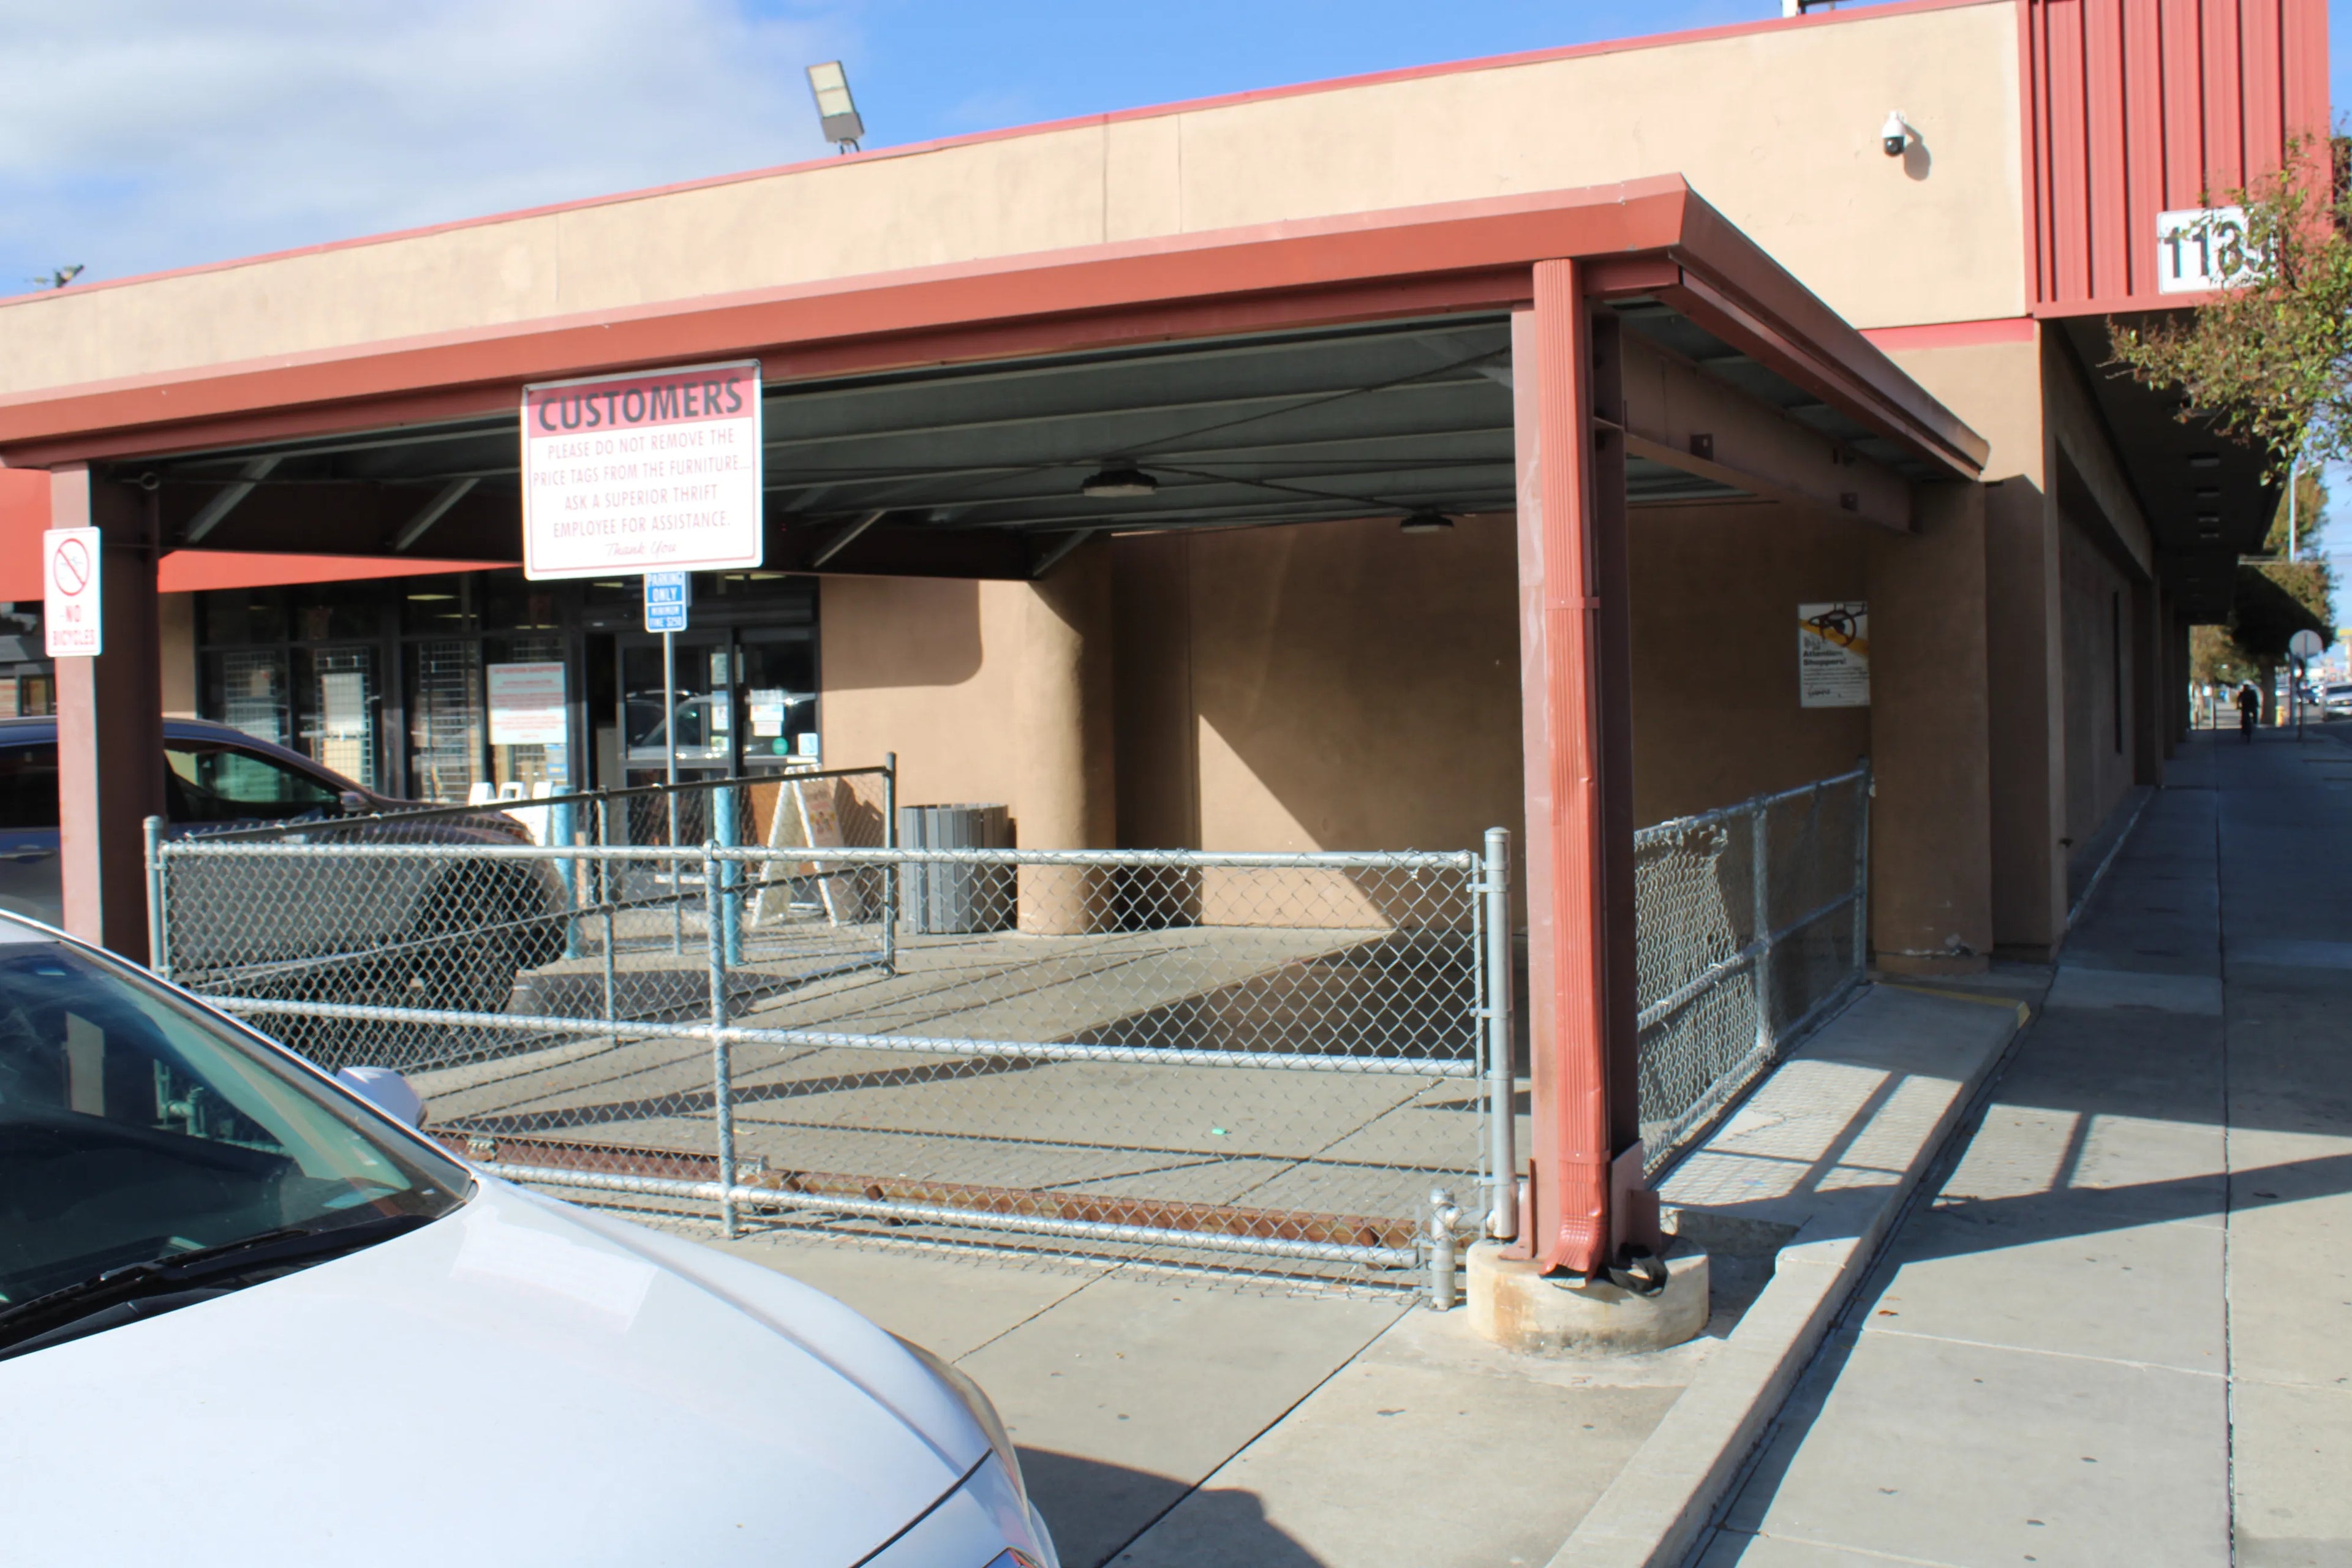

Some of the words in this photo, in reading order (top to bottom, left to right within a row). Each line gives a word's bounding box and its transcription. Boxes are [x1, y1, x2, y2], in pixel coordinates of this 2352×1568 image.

[539, 377, 742, 431] CUSTOMERS
[548, 441, 589, 459] PLEASE
[595, 440, 614, 456] DO
[619, 437, 645, 453] NOT
[651, 431, 704, 451] REMOVE
[710, 428, 734, 445] THE
[533, 470, 565, 487] PRICE
[571, 467, 599, 484] TAGS
[604, 464, 638, 481] FROM
[643, 461, 664, 478] THE
[565, 494, 587, 510] ASK
[592, 493, 600, 509] A
[605, 488, 668, 508] SUPERIOR
[673, 484, 717, 502] THRIFT
[554, 519, 616, 538] EMPLOYEE
[622, 517, 646, 533] FOR
[652, 511, 731, 531] ASSISTANCE.
[604, 541, 645, 557] Thank
[650, 540, 677, 560] You
[652, 587, 677, 602] ONLY
[65, 605, 82, 622] NO
[53, 628, 95, 646] BICYCLES
